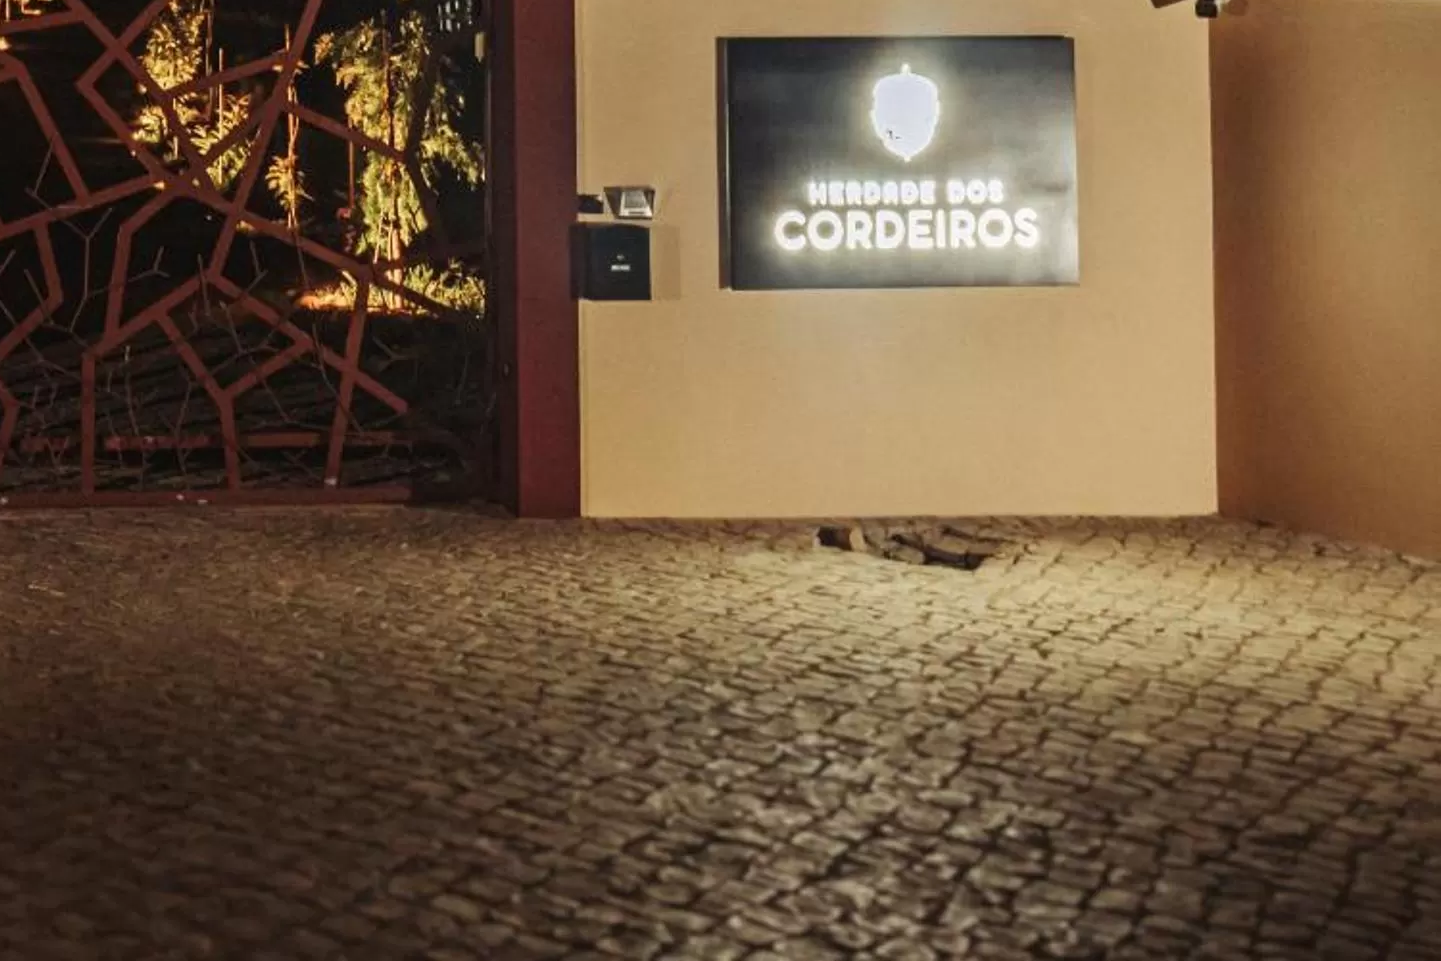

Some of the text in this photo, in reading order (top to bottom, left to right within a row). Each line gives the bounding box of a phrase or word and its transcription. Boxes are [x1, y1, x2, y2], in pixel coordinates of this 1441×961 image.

[808, 179, 1004, 205] HERDADE DOS
[774, 208, 1039, 251] CORDEIROS
